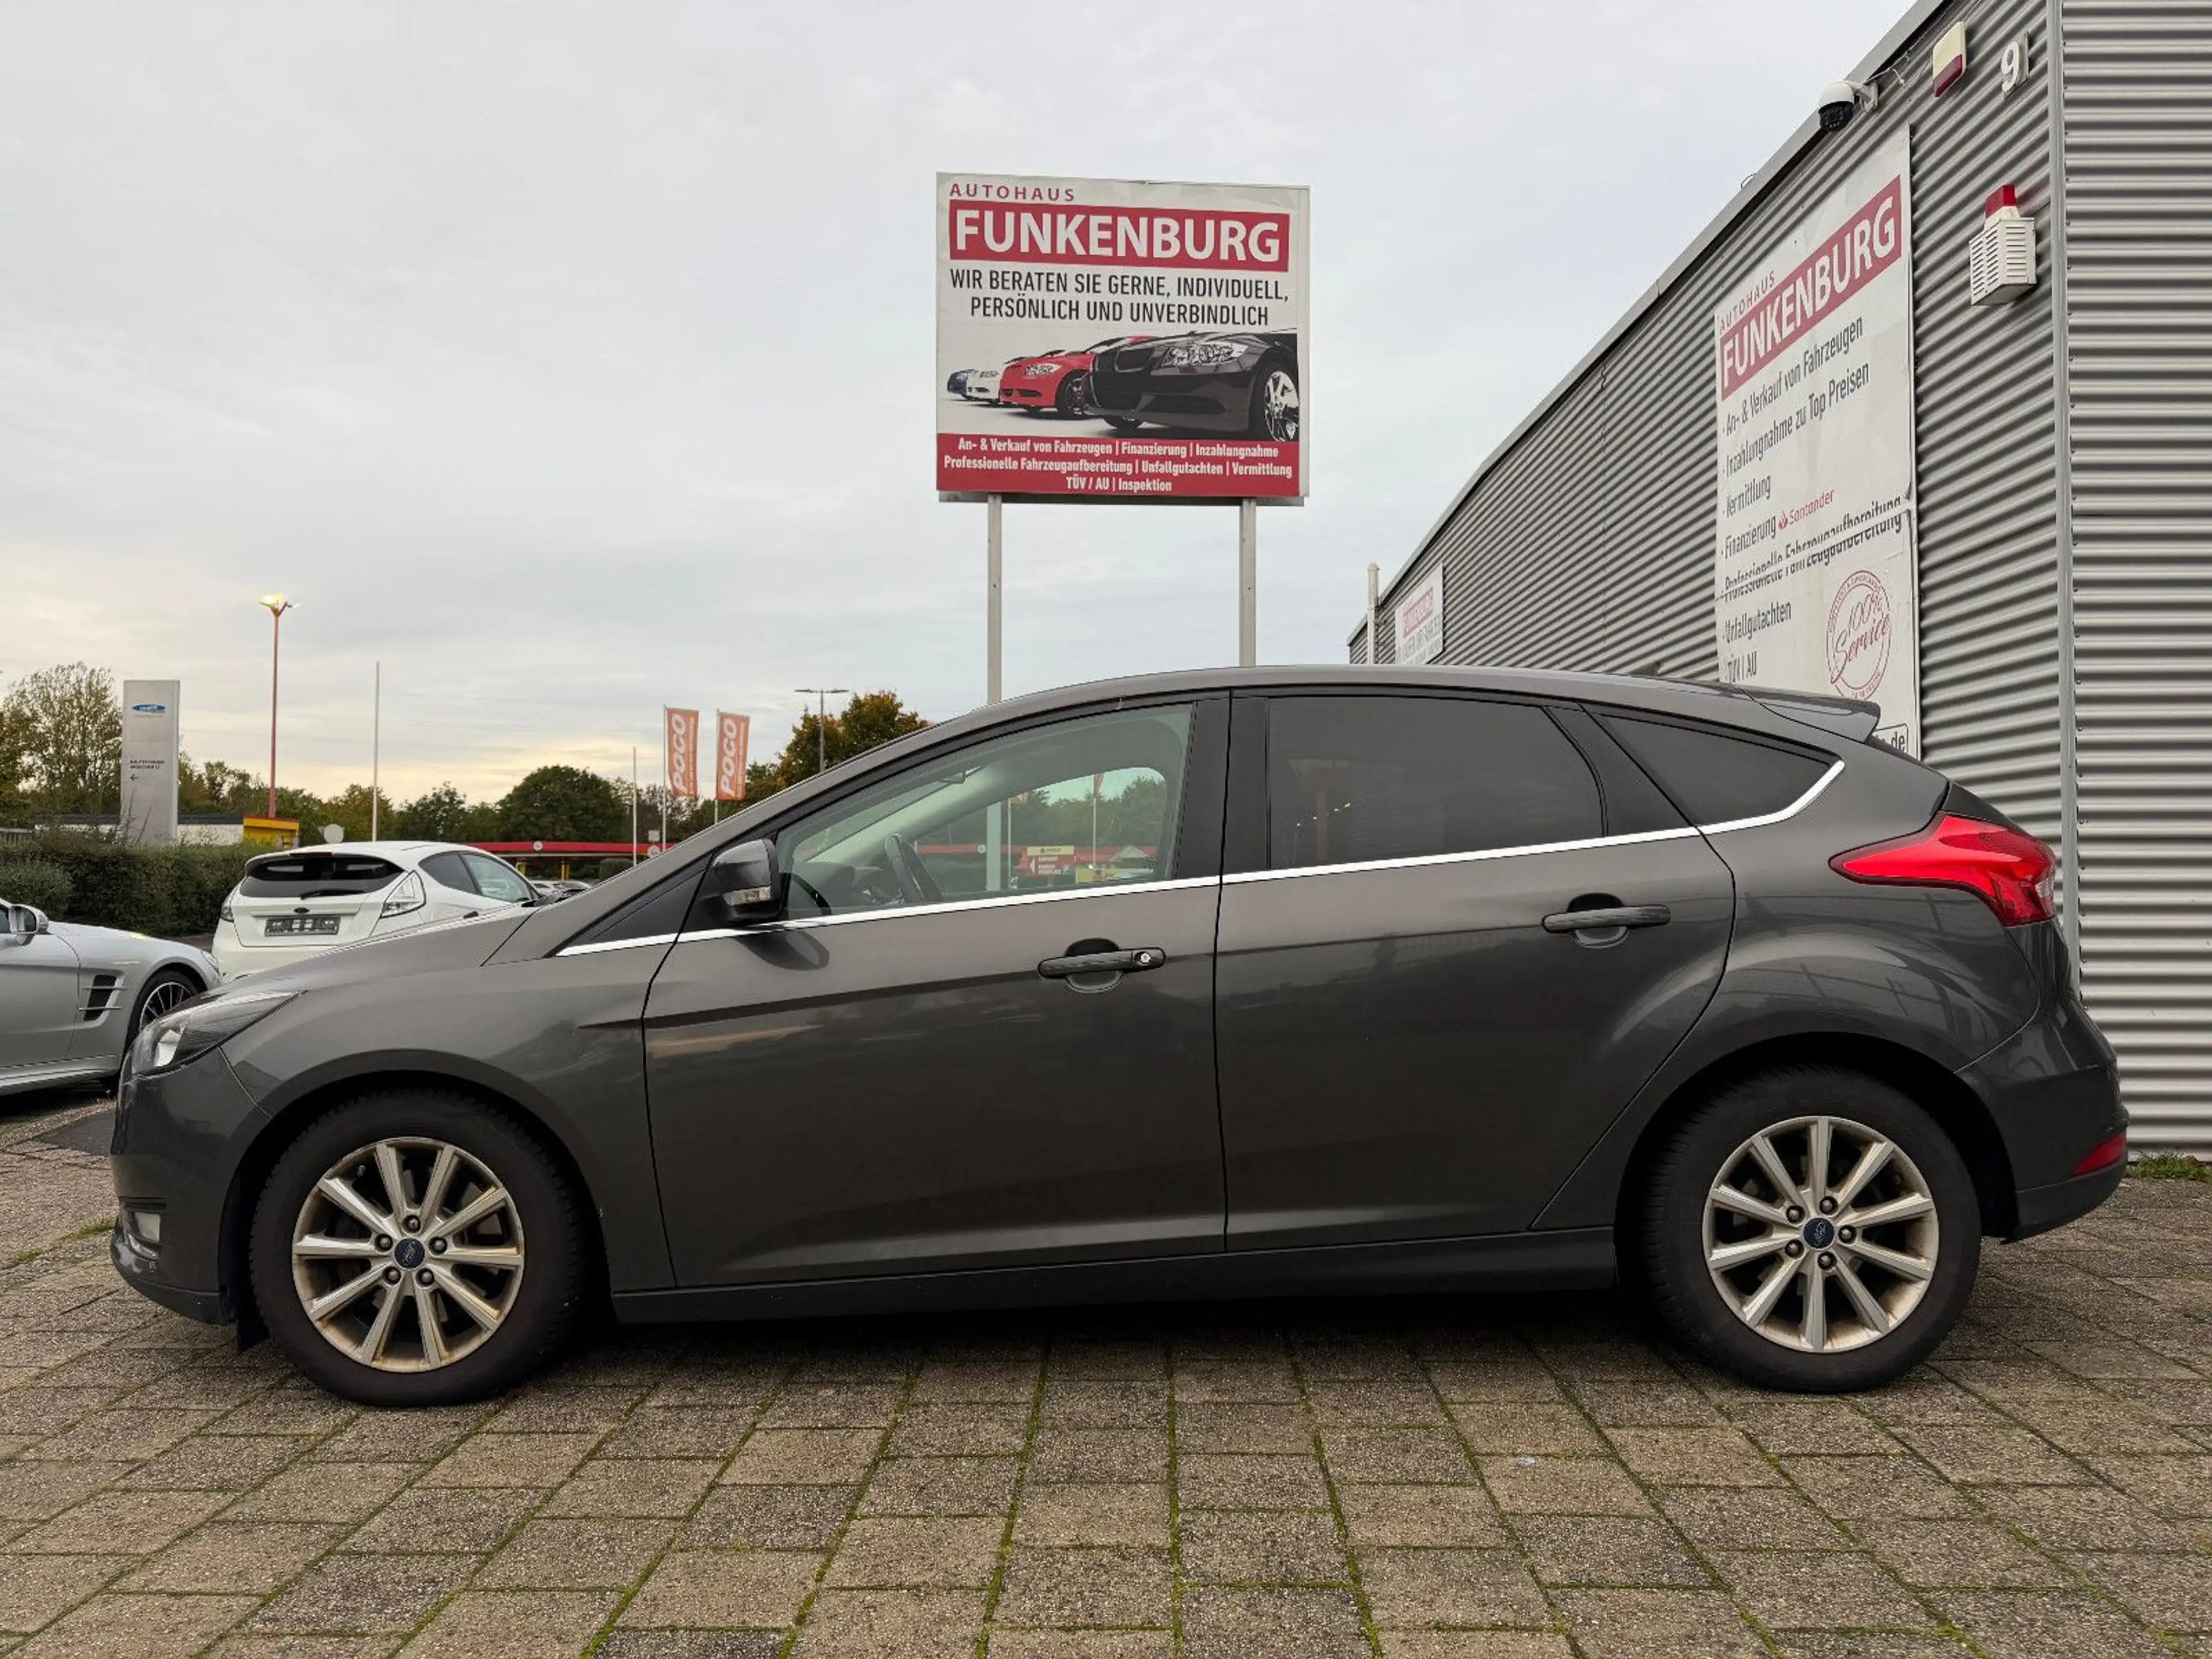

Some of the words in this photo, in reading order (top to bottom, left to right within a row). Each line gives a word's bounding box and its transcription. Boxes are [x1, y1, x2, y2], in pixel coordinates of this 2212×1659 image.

[2001, 41, 2021, 92] 9
[950, 183, 1074, 201] AUTOHAUS
[957, 209, 1281, 263] FUNKENBURG
[950, 268, 982, 289] WIR
[990, 270, 1067, 292] BERATEN
[1074, 274, 1101, 294] SIE
[1108, 275, 1171, 298] GERNE,
[1177, 277, 1288, 302] INDIVIDUELL,
[971, 293, 1079, 320] PERSÖNLICH
[1086, 301, 1122, 321] UND
[1130, 302, 1268, 325] UNVERBINDLICH
[1719, 270, 1775, 335] AUTOHAUS
[1724, 196, 1895, 389] FUNKENBURG
[1750, 370, 1782, 418] Verkauf
[1785, 363, 1801, 392] von
[1804, 316, 1863, 377] Fahrzeugen
[1726, 415, 1793, 478] Inzahlungnahme
[1796, 405, 1807, 430] zu
[1809, 392, 1826, 421] Top
[1829, 362, 1869, 408] Preisen
[944, 454, 1018, 470] Professionelle
[1021, 457, 1132, 474] Fahrzeugaufbereitung
[1142, 460, 1224, 476] Unfallgutachten
[1232, 461, 1293, 479] Vermittlung
[958, 437, 977, 450] An-
[980, 438, 988, 451] &
[990, 438, 1031, 452] Verkauf
[1033, 442, 1052, 453] von
[1054, 440, 1112, 457] Fahrzeugen
[1122, 442, 1187, 459] Finanzierung
[1196, 443, 1279, 460] Inzahlungnahme
[1066, 474, 1086, 490] TÜV
[1096, 476, 1109, 490] AU
[1119, 479, 1172, 493] Inspektion
[1726, 475, 1771, 518] Vermittlung
[1725, 516, 1777, 559] Finanzierung
[1789, 490, 1834, 524] Santander
[1725, 601, 1791, 643] Unfallgutachten
[1831, 613, 1890, 684] Service
[672, 714, 688, 795] POCO
[721, 718, 736, 797] POCO
